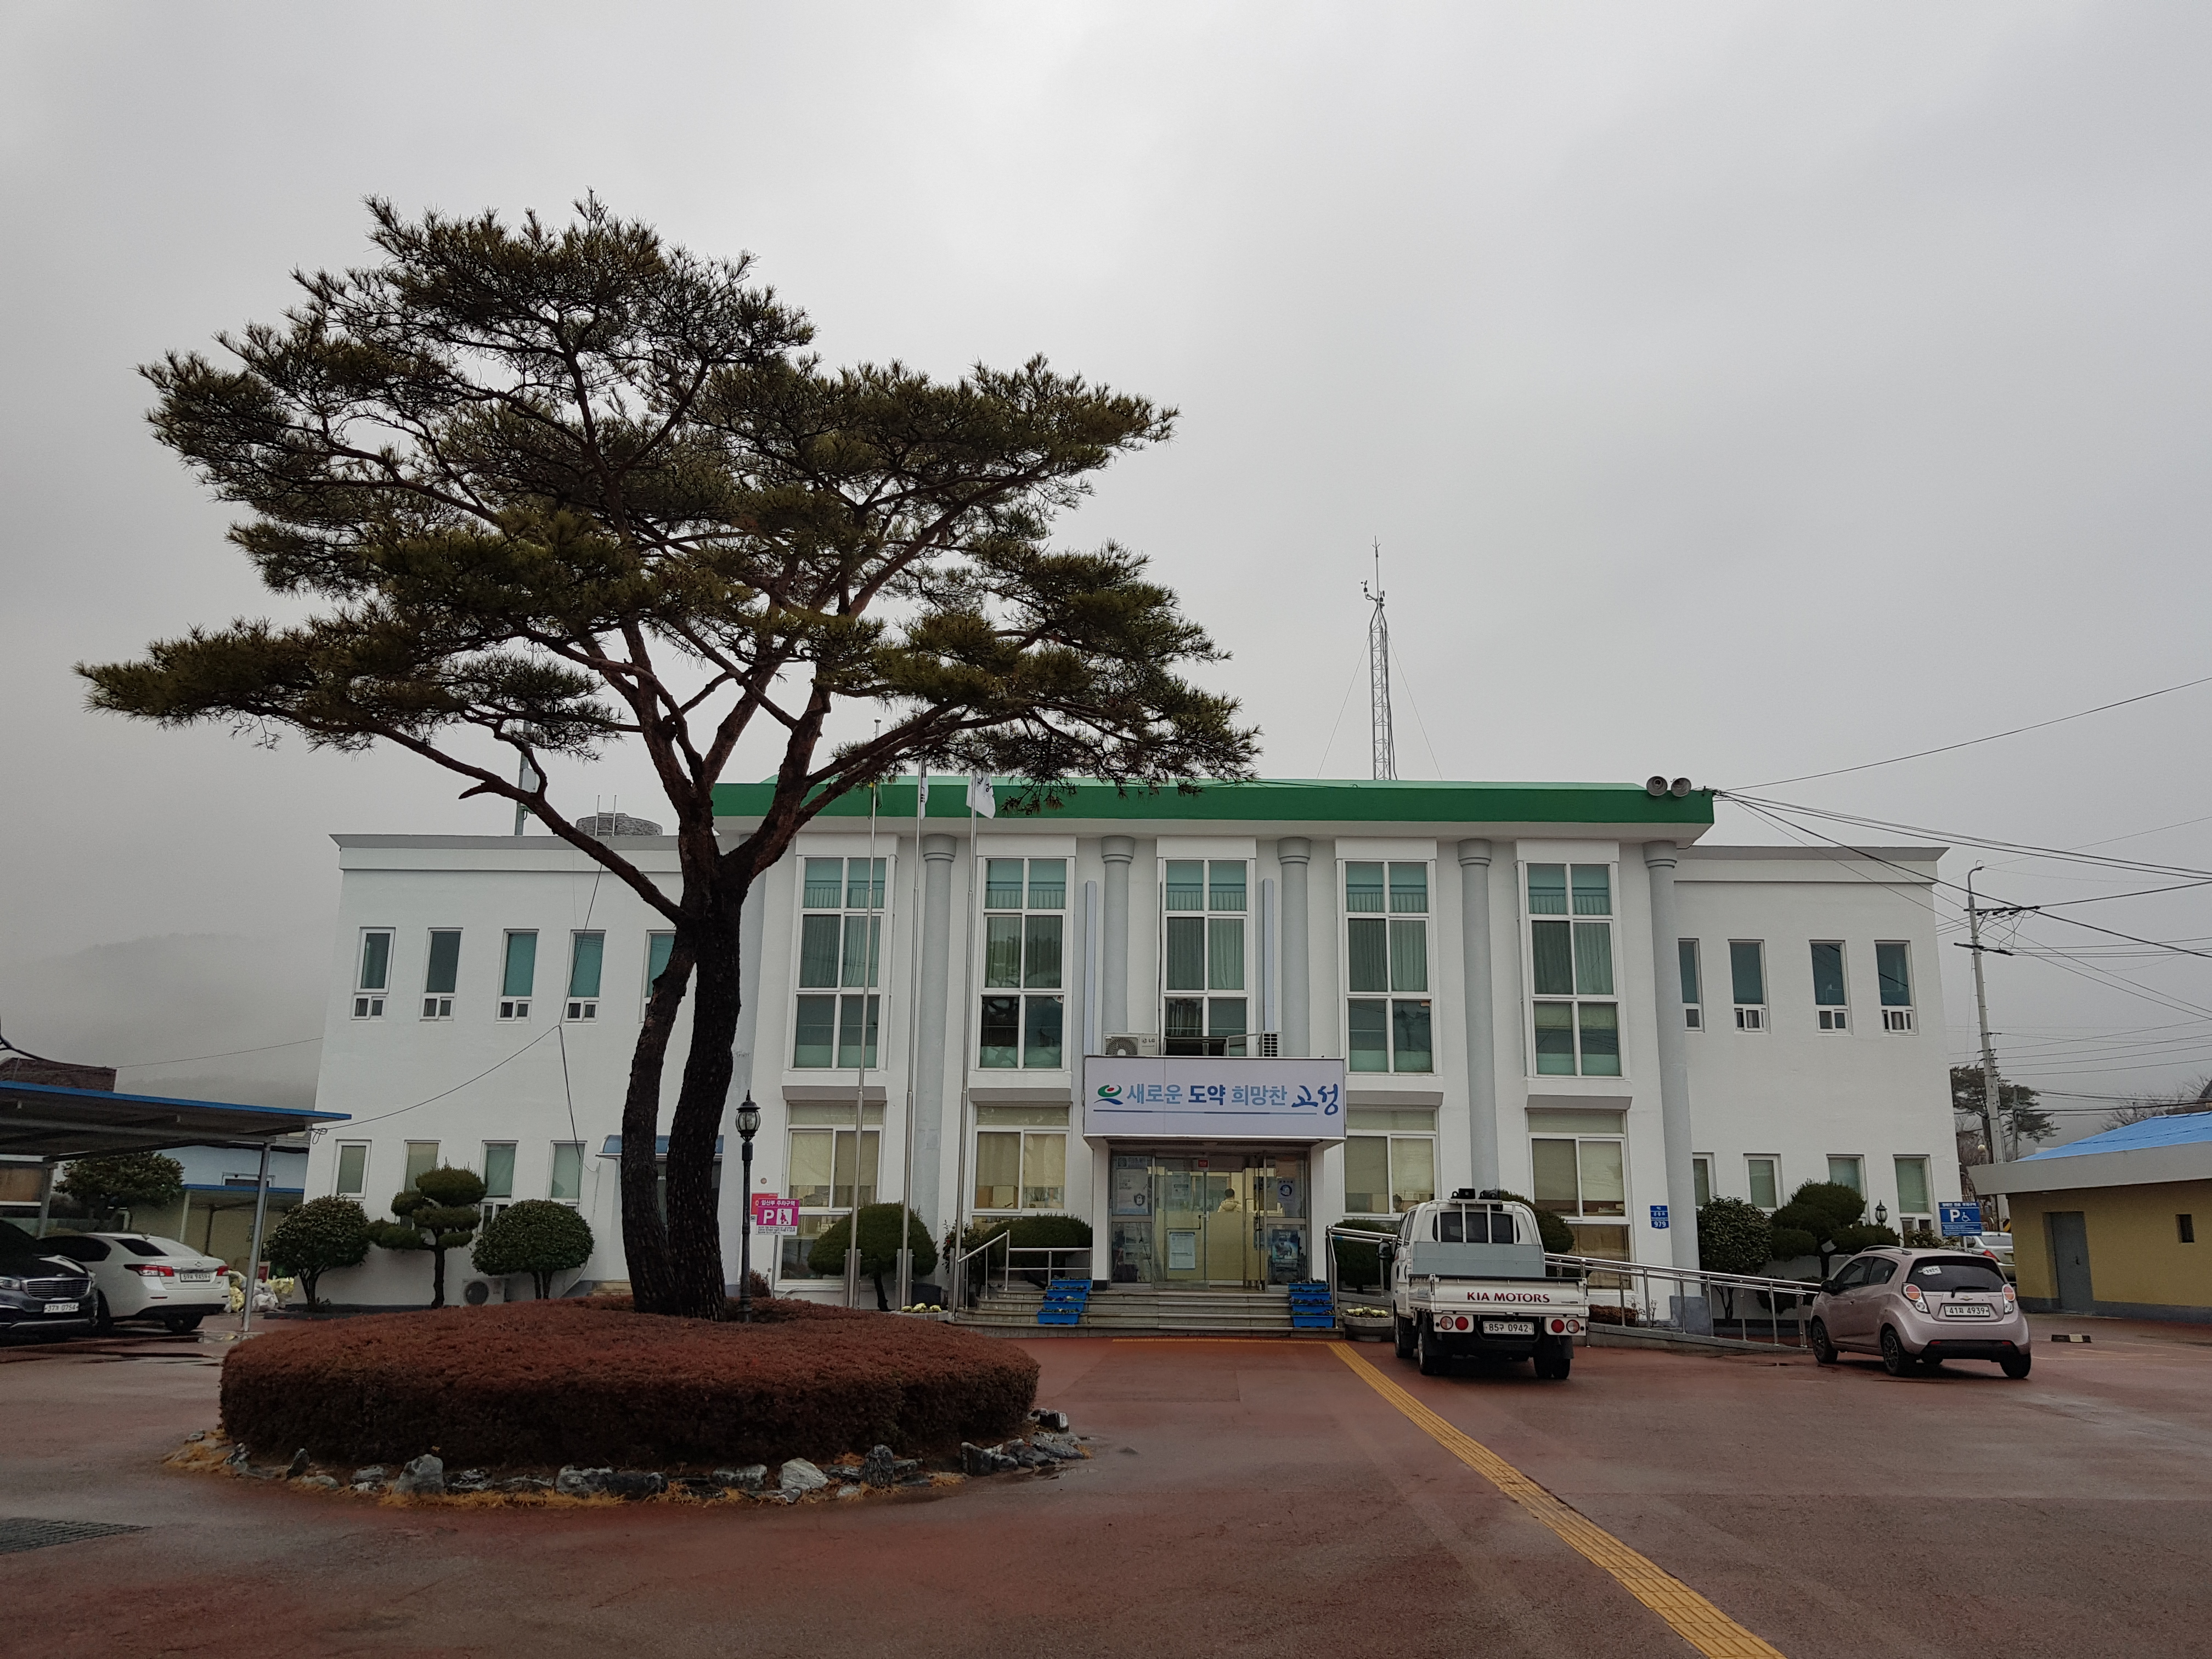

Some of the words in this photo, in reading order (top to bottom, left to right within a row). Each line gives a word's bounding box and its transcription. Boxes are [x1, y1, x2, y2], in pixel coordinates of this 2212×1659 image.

[1126, 1083, 1183, 1104] 새로운
[1188, 1084, 1226, 1106] 도약
[1231, 1085, 1288, 1106] 희망찬
[1291, 1083, 1339, 1115] 고성
[763, 1209, 775, 1224] P
[1949, 1209, 1961, 1222] P
[1467, 1291, 1490, 1301] KIA
[1494, 1293, 1550, 1303] MOTORS
[1508, 1323, 1529, 1333] 0942
